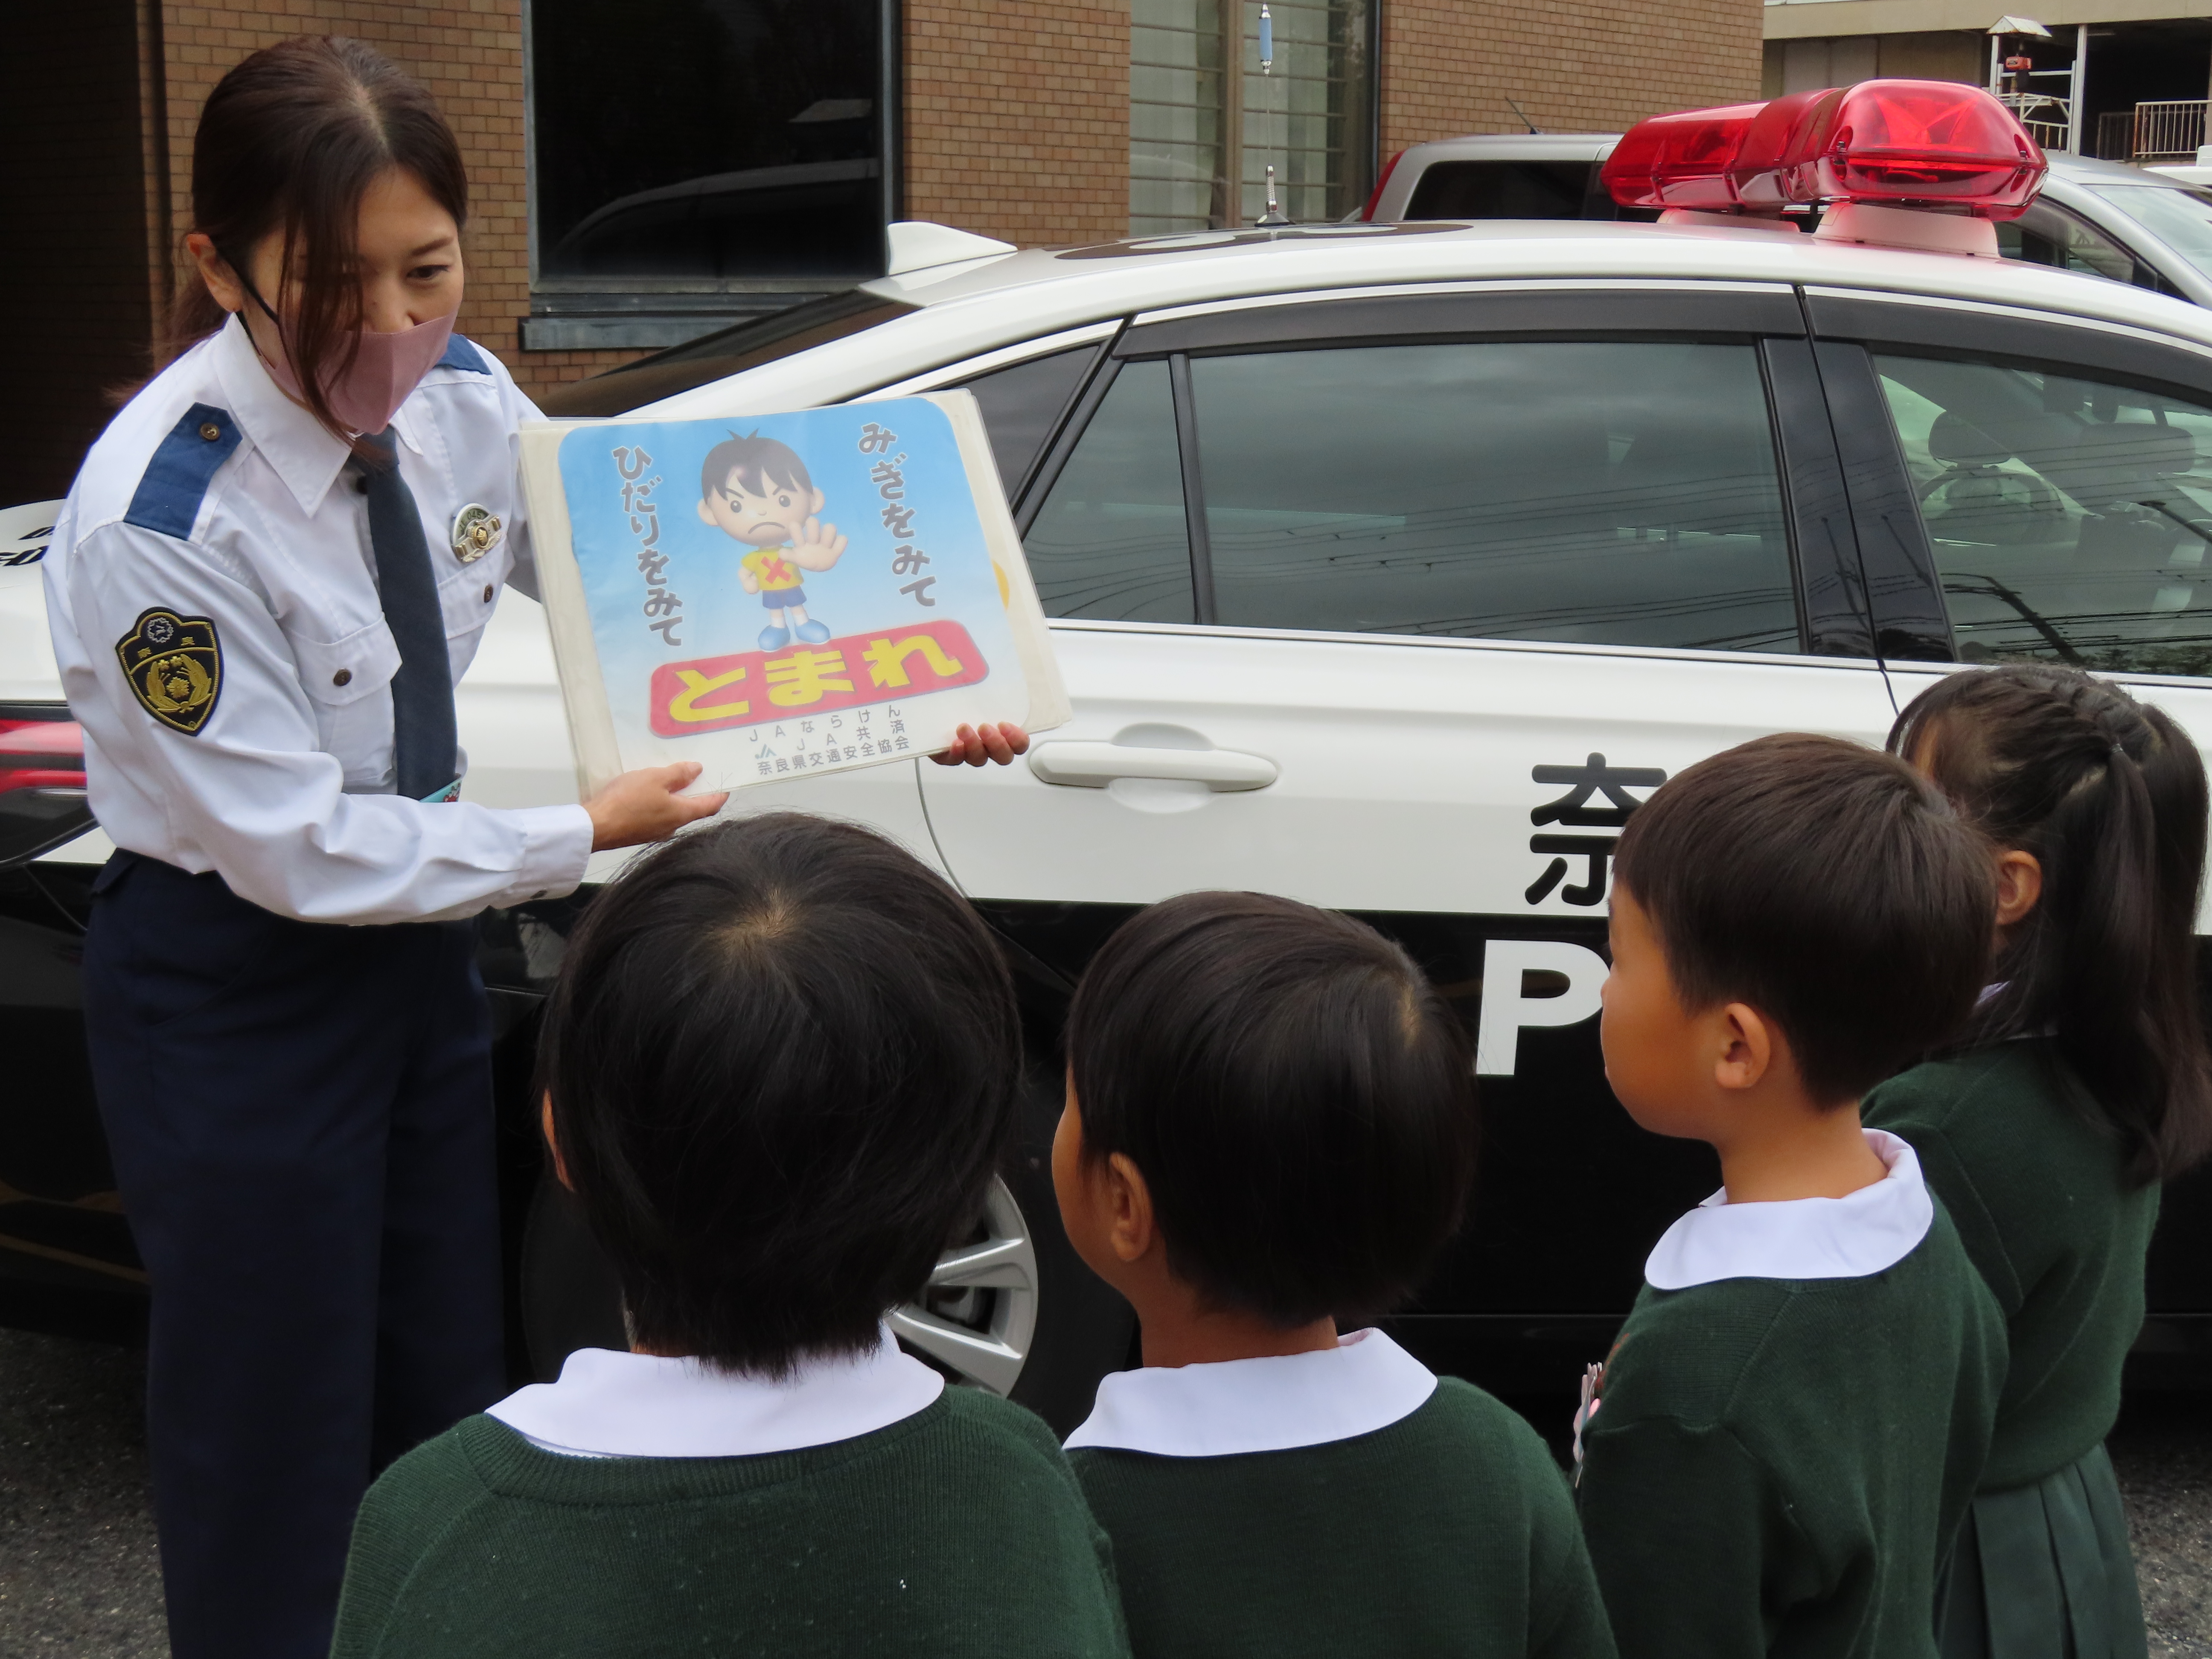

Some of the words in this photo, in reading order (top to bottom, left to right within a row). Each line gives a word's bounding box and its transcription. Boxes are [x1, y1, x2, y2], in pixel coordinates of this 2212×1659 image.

[612, 445, 684, 647] ひだりをみて
[858, 422, 937, 608] みぎをみて
[668, 633, 964, 723] とまれ
[757, 735, 910, 776] 奈良県交通安全協会
